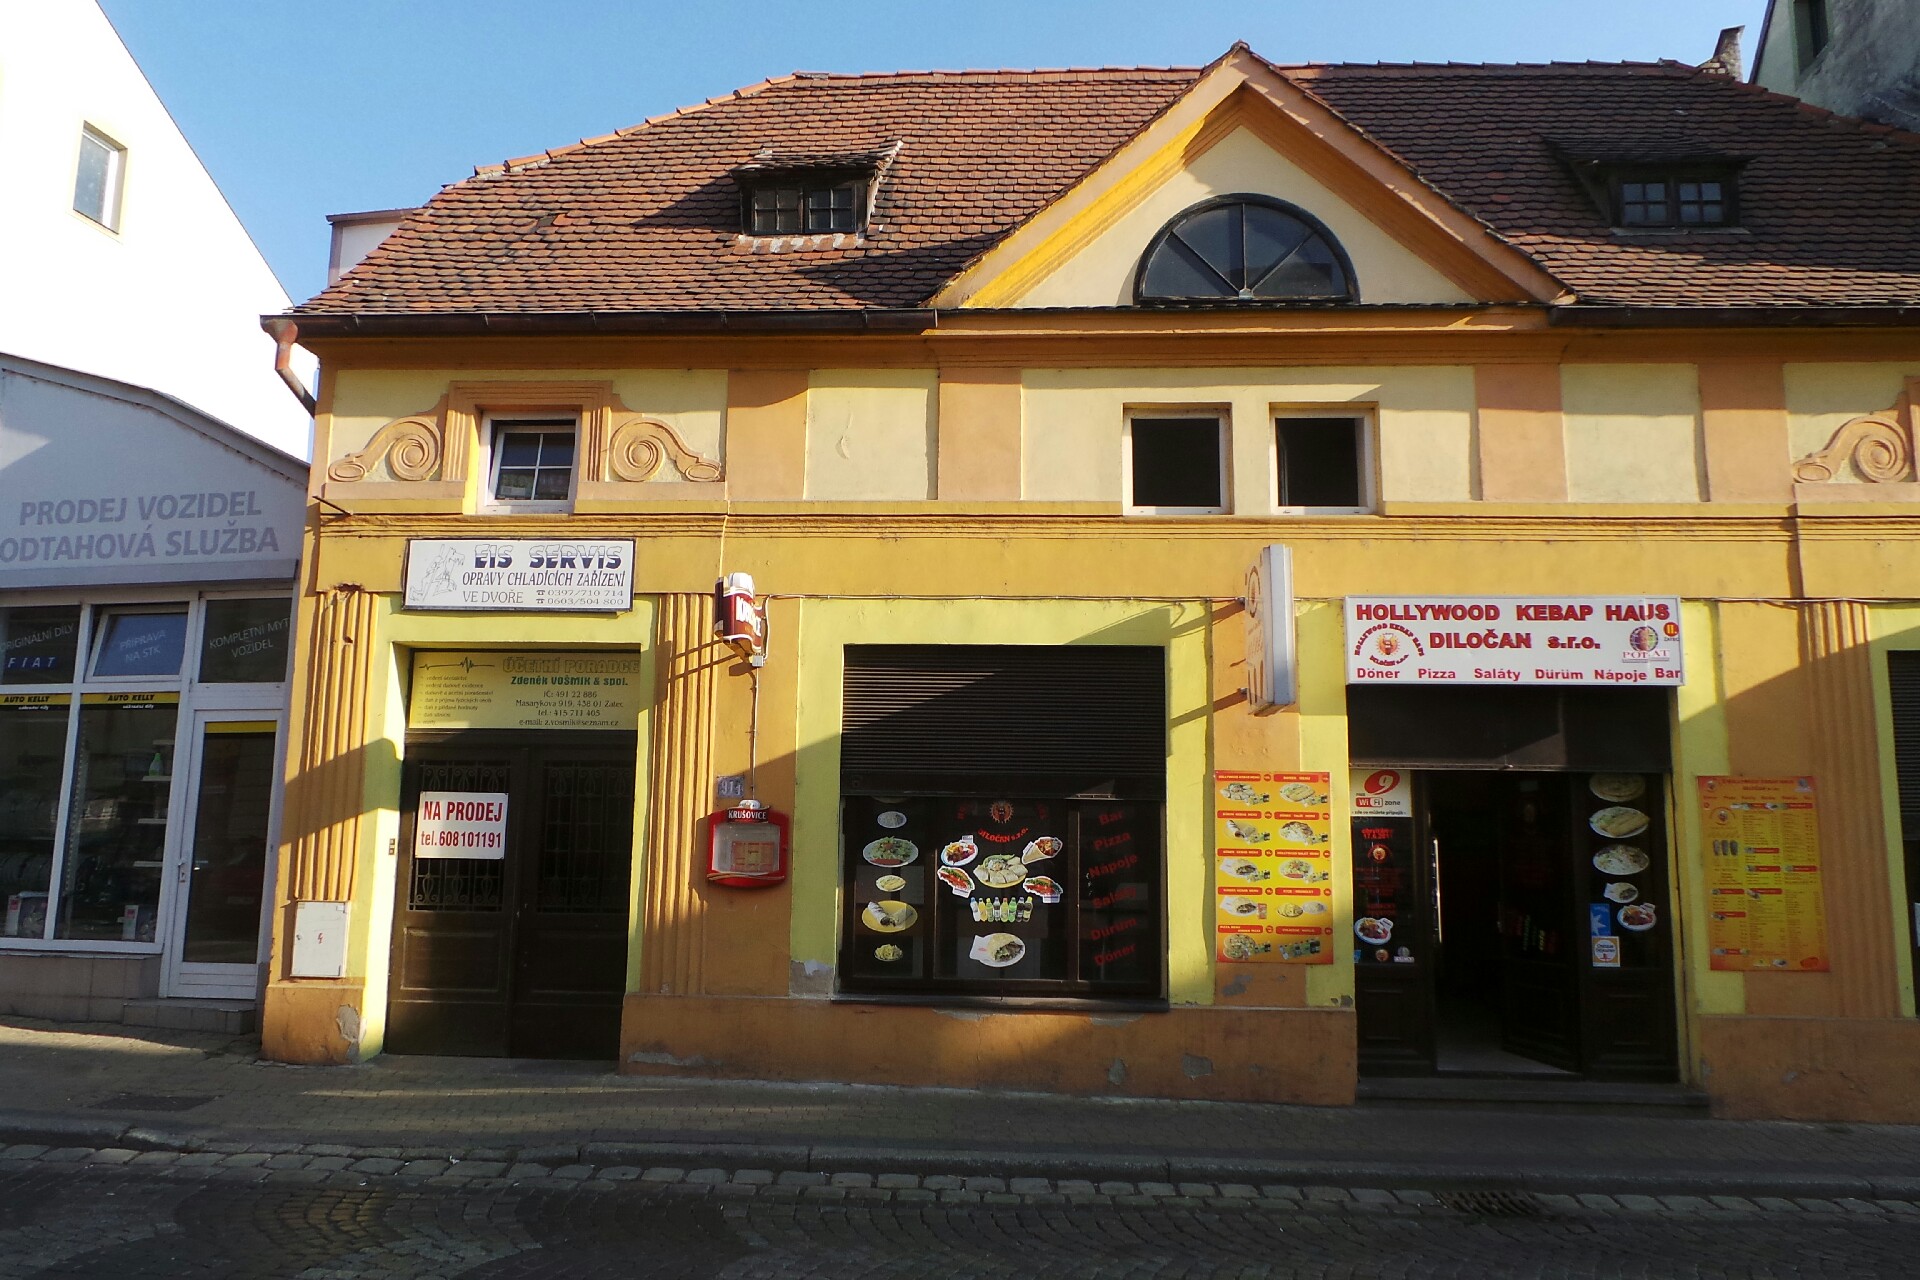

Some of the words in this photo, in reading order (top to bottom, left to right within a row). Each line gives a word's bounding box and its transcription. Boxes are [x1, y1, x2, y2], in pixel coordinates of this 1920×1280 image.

[19, 498, 127, 526] PRODEJ
[138, 491, 262, 521] VOZIDEL
[0, 524, 156, 563] ODTAHOVÁ
[165, 520, 280, 557] SLUŽBA
[475, 544, 513, 568] EIS
[529, 544, 623, 569] SERVIS
[462, 572, 504, 586] OPRAVY
[507, 570, 574, 587] CHLADÍCÍCH
[576, 570, 626, 587] ZAŘÍZENÍ
[463, 591, 479, 603] VE
[481, 589, 524, 604] DVOŘE
[547, 589, 601, 597] 0397/710
[604, 589, 624, 597] 714
[1356, 604, 1500, 621] HOLLYWOOD
[1516, 604, 1593, 621] KEBAP
[1605, 603, 1671, 622] HAUS
[1354, 623, 1388, 656] HOLLYWOOD
[1429, 629, 1532, 649] DILOČAN
[1547, 635, 1601, 650] s.r.o.
[231, 638, 274, 659] VOZIDEL
[7, 656, 55, 668] FIAT
[503, 656, 560, 673] ÚČETNÍ
[564, 659, 640, 674] PORADCE
[511, 675, 548, 685] Zdeněk
[551, 674, 590, 686] VOŠMIK
[593, 677, 600, 685] &
[603, 676, 628, 687] spol.
[1357, 668, 1400, 679] Döner
[1418, 669, 1456, 679] Pizza
[1474, 668, 1521, 682] Saláty
[1535, 669, 1584, 680] Dürüm
[1594, 669, 1648, 682] Nápoje
[1655, 667, 1681, 679] Bar
[571, 690, 581, 698] 22
[515, 699, 557, 709] Masarykova
[423, 801, 441, 821] NA
[446, 801, 503, 822] PRODEJ
[728, 809, 767, 820] KRUŠOVICE
[1098, 810, 1124, 825] Bar
[1093, 831, 1132, 851] Pizza
